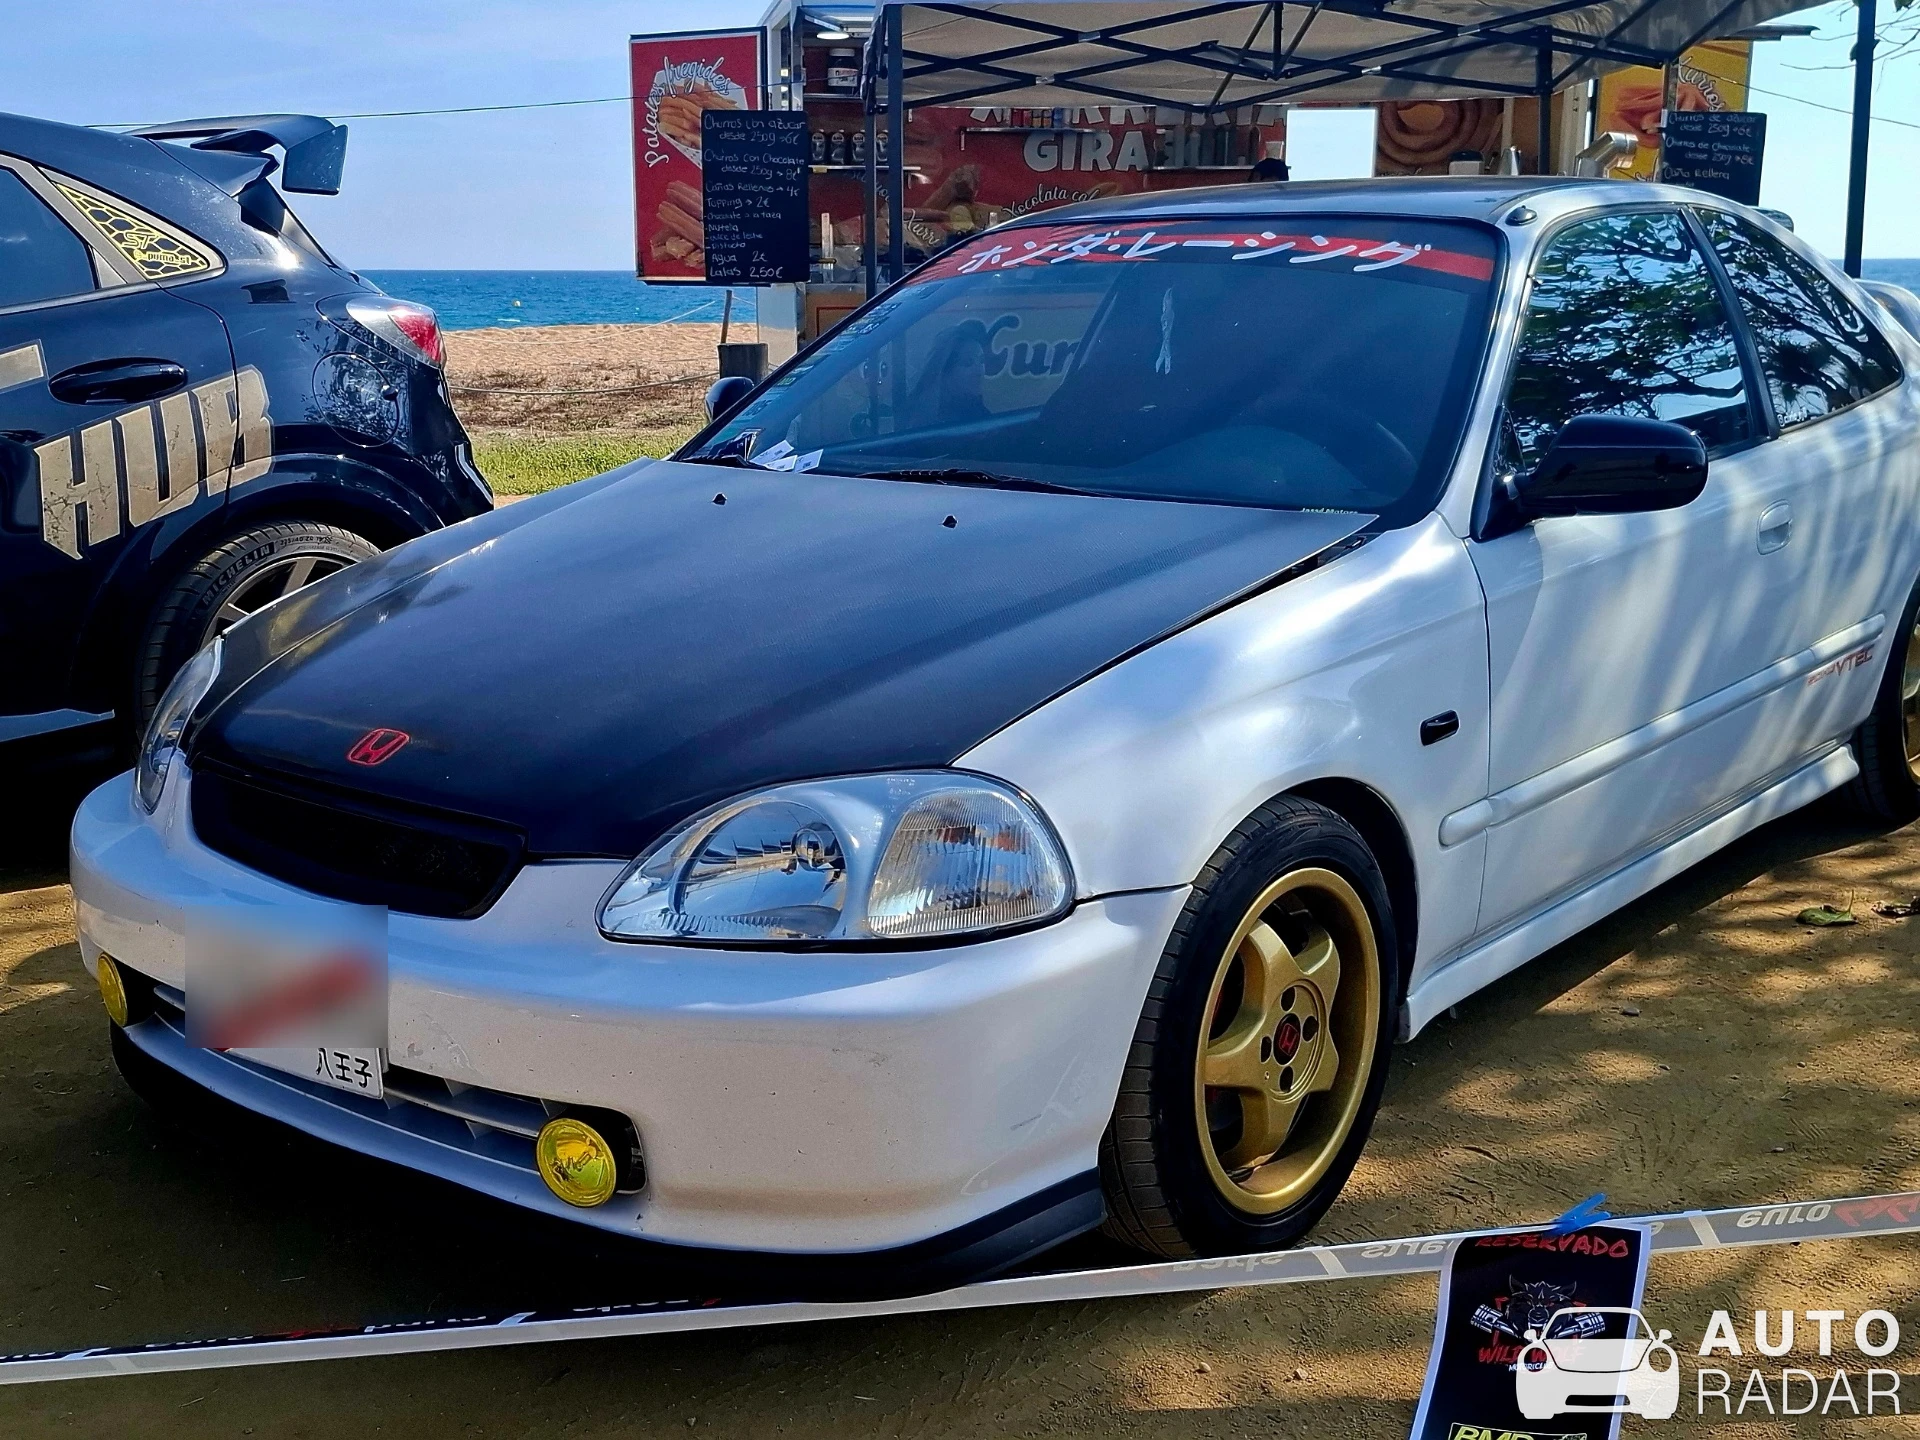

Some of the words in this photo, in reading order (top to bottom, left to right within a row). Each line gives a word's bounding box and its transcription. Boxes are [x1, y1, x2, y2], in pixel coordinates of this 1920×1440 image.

[712, 253, 738, 265] Agua
[202, 545, 271, 607] MICHELIN
[1474, 1233, 1630, 1258] RESERVADO
